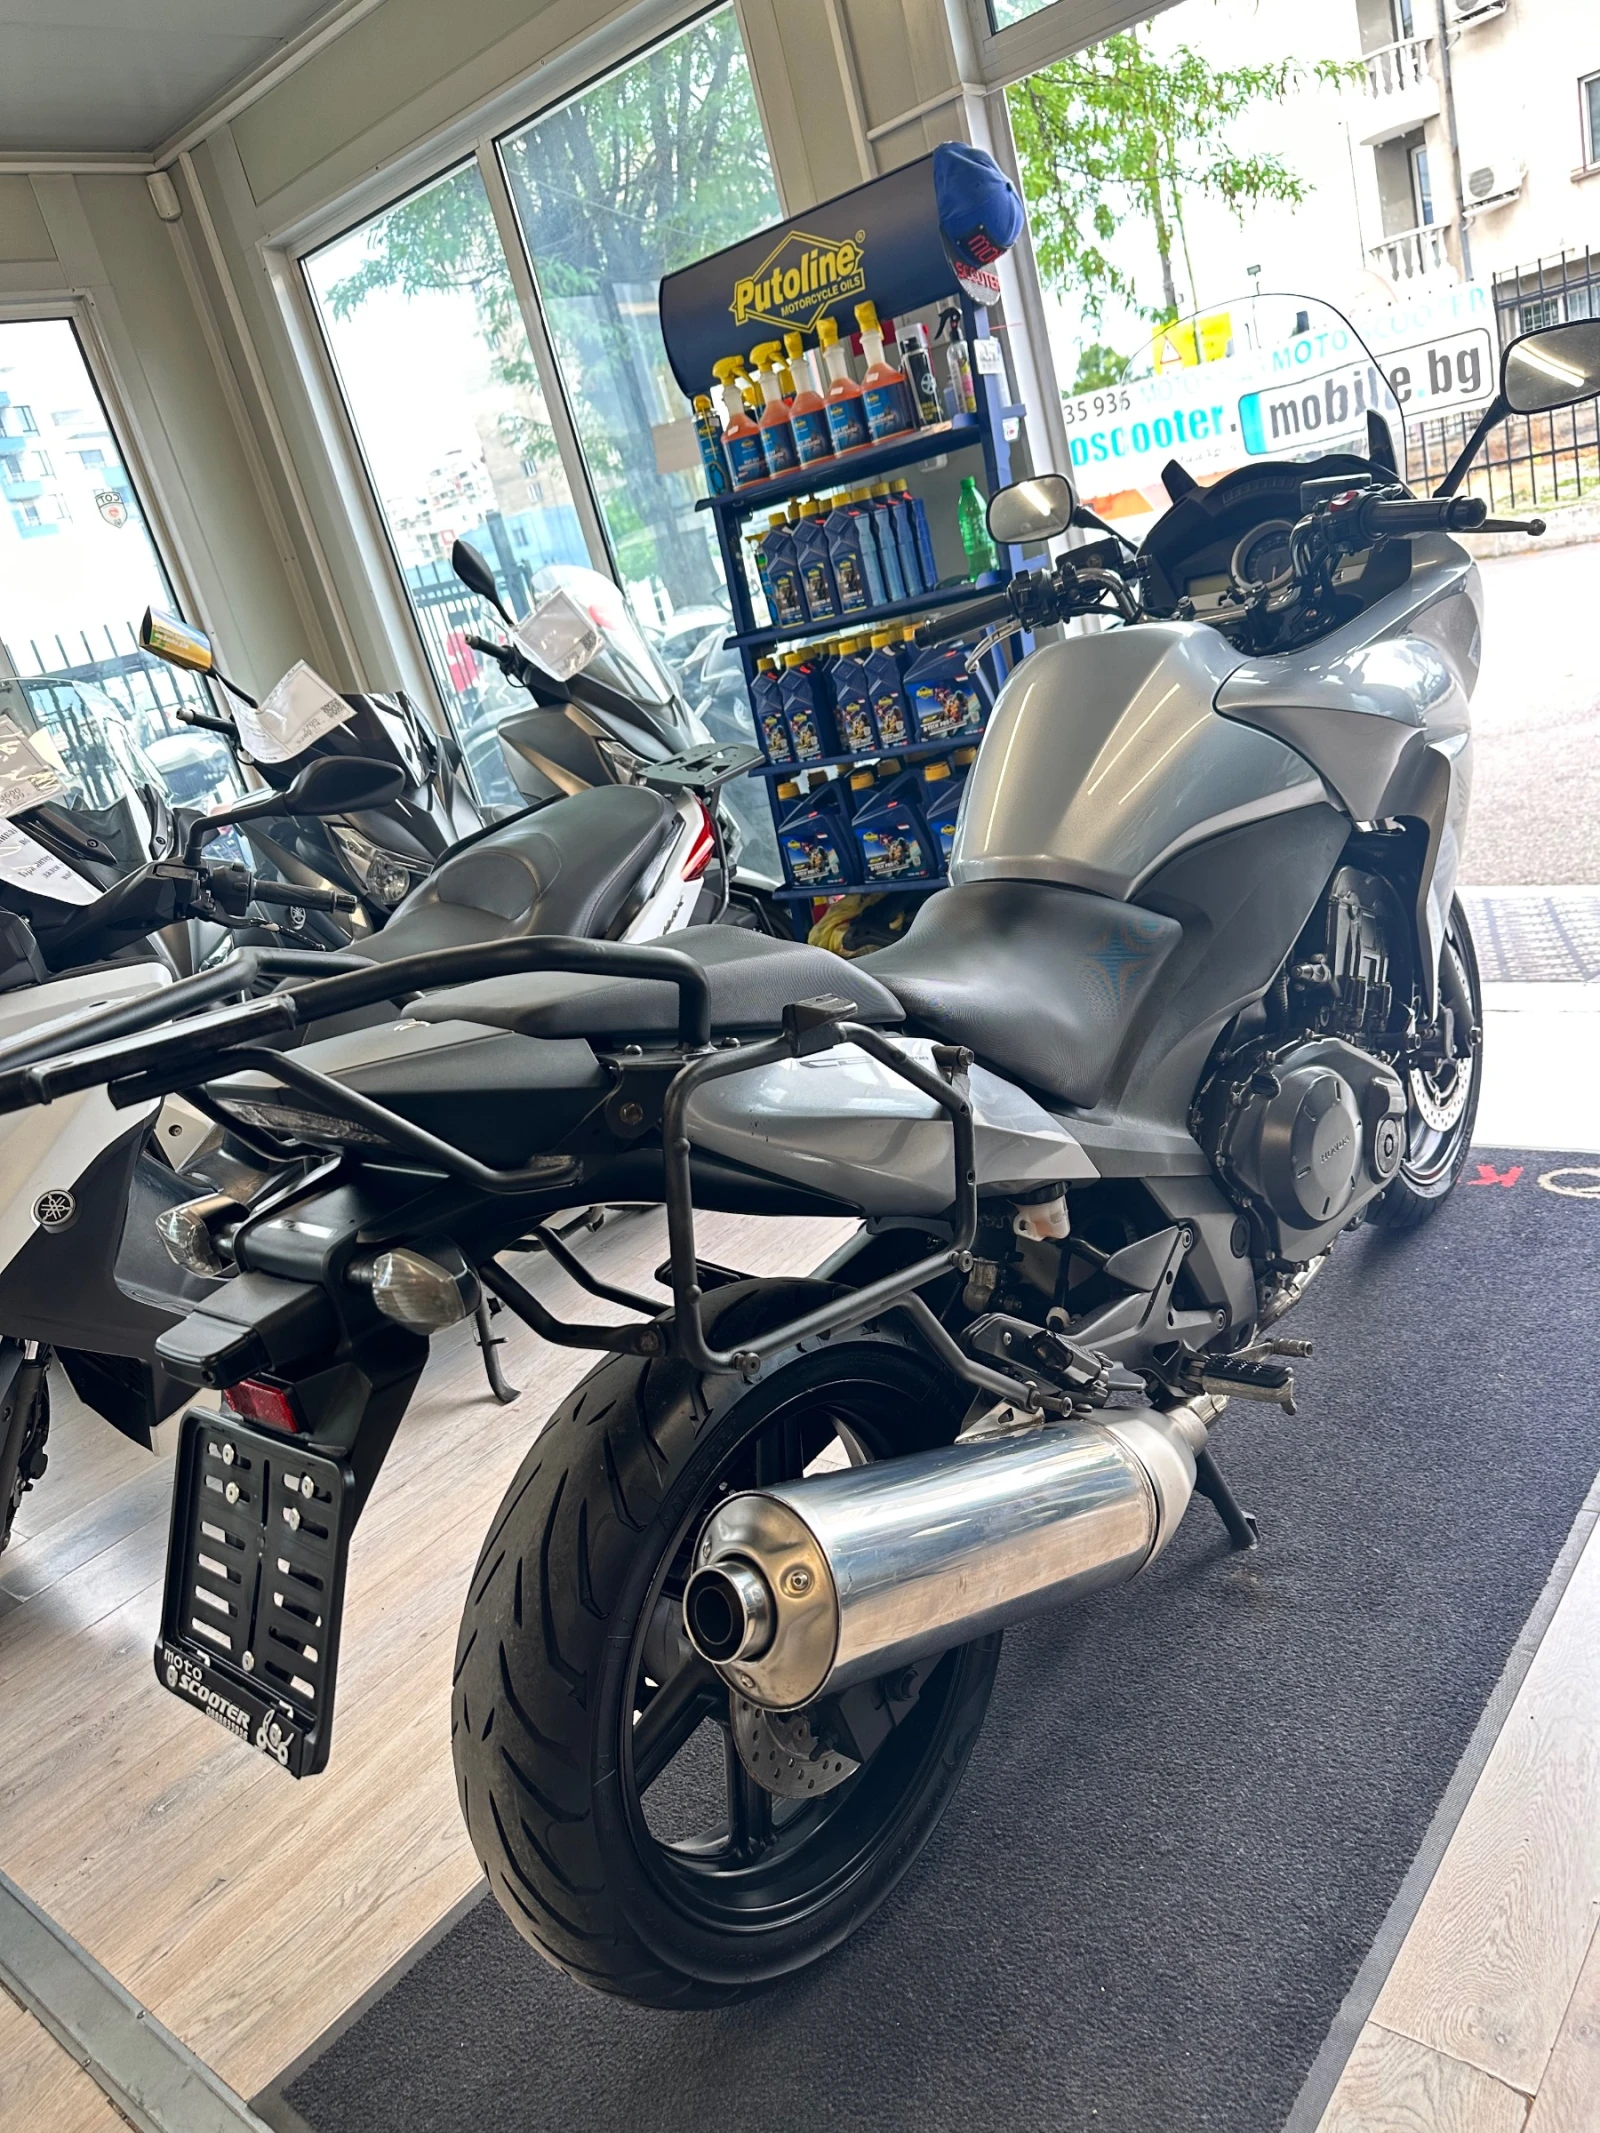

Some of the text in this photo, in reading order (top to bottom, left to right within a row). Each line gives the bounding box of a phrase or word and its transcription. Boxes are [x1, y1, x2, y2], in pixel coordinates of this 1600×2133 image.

[736, 244, 856, 322] Putoline
[781, 276, 861, 317] MOTORCYCLE OILS
[1271, 329, 1349, 372] MOTO
[1269, 347, 1482, 439] mobile.bg
[163, 1648, 203, 1682] moto
[178, 1674, 251, 1731] SCOOTER
